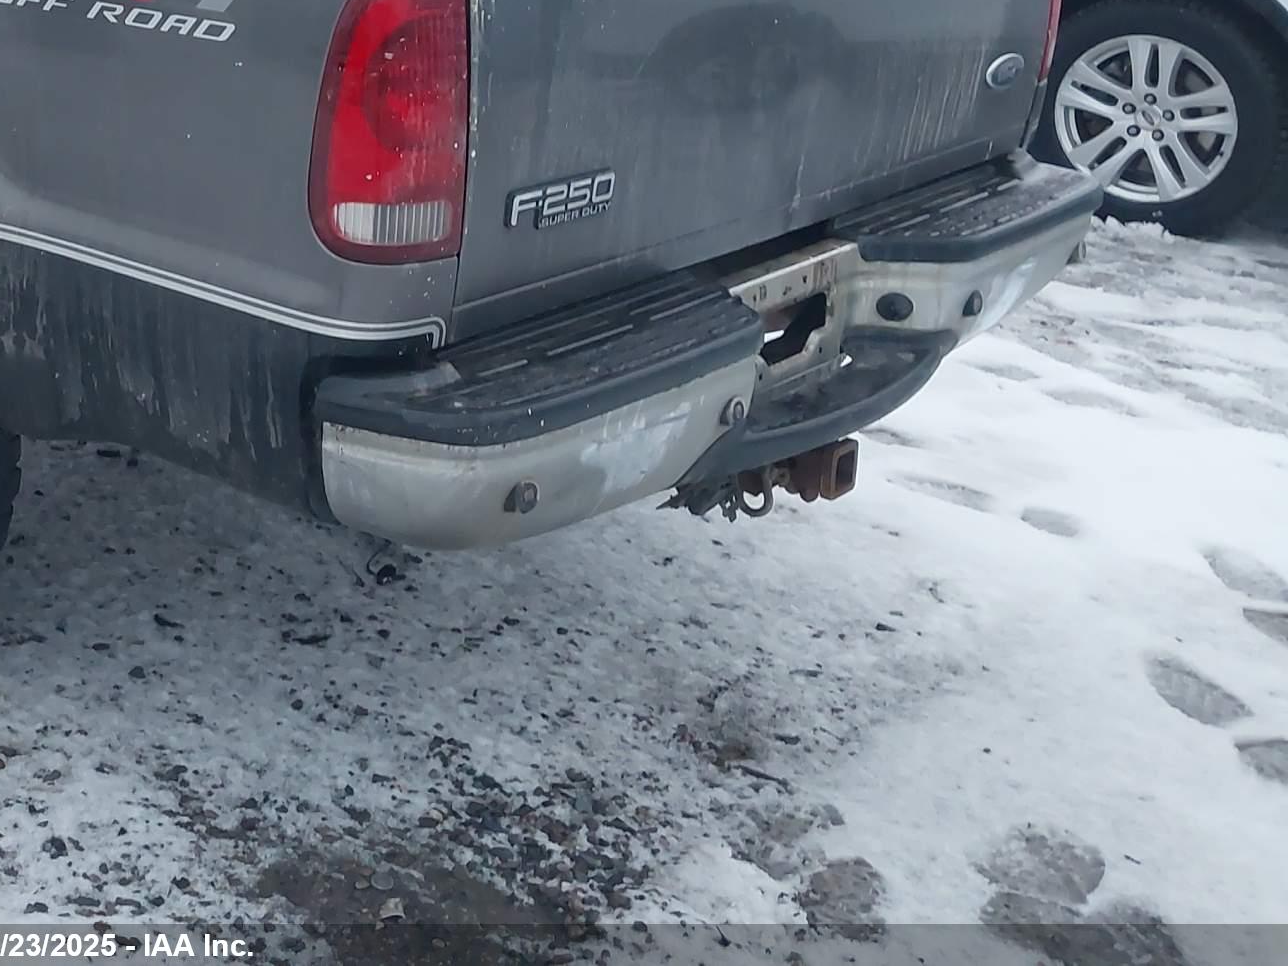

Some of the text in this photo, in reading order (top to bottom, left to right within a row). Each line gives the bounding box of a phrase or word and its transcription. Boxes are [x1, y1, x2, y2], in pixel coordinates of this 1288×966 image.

[86, 1, 237, 42] ROAD
[538, 201, 612, 228] SUPER DUTY
